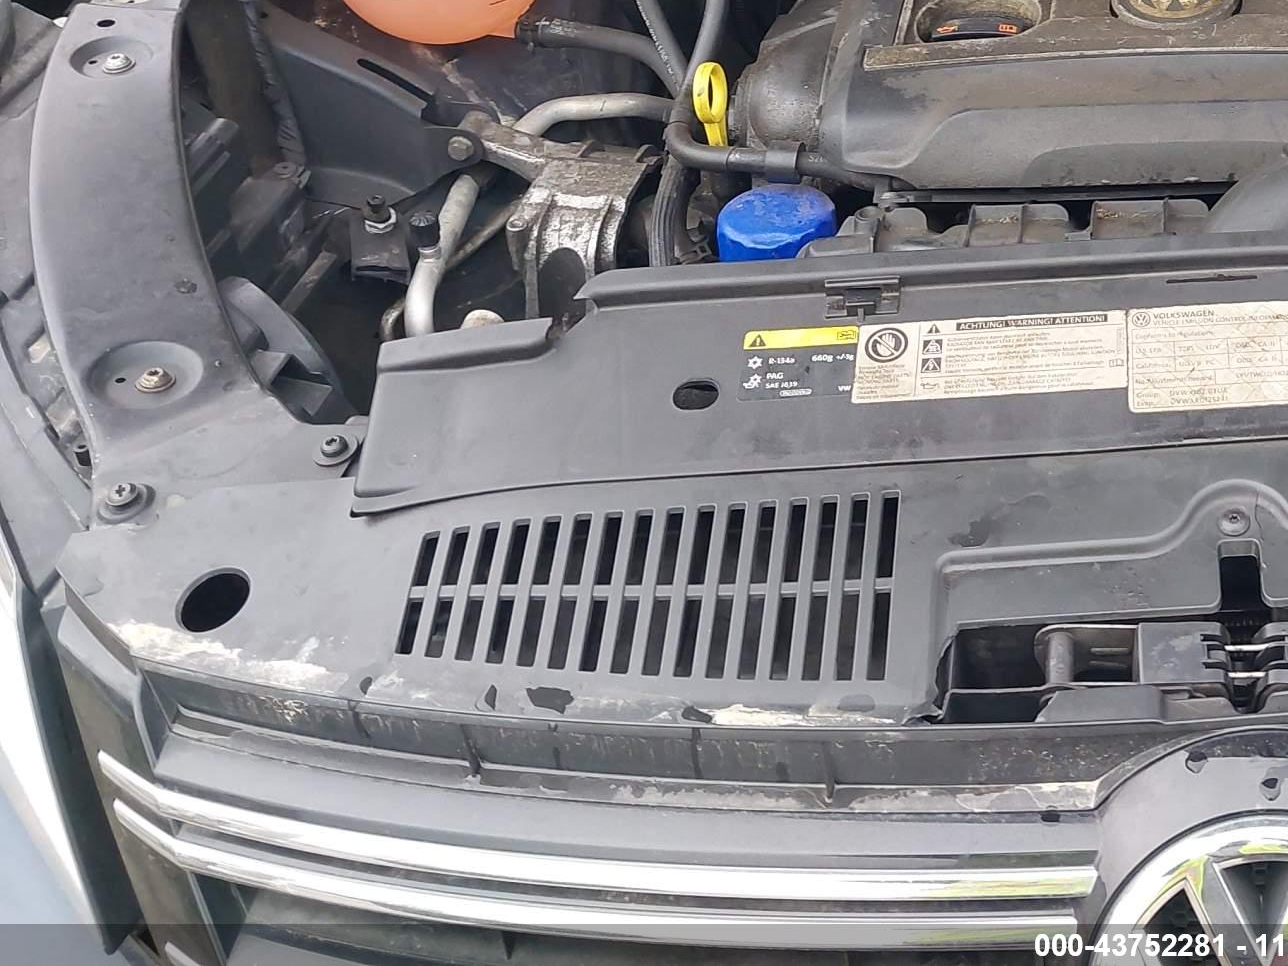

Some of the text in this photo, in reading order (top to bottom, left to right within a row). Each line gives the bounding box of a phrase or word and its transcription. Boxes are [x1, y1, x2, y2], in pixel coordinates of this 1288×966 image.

[1153, 309, 1214, 319] VOLKSWAGEN
[960, 315, 1105, 330] ACHTUNG! WARNING! ATTENTION!
[768, 357, 796, 365] R-134a
[811, 354, 834, 363] 660g
[766, 372, 784, 380] PAG
